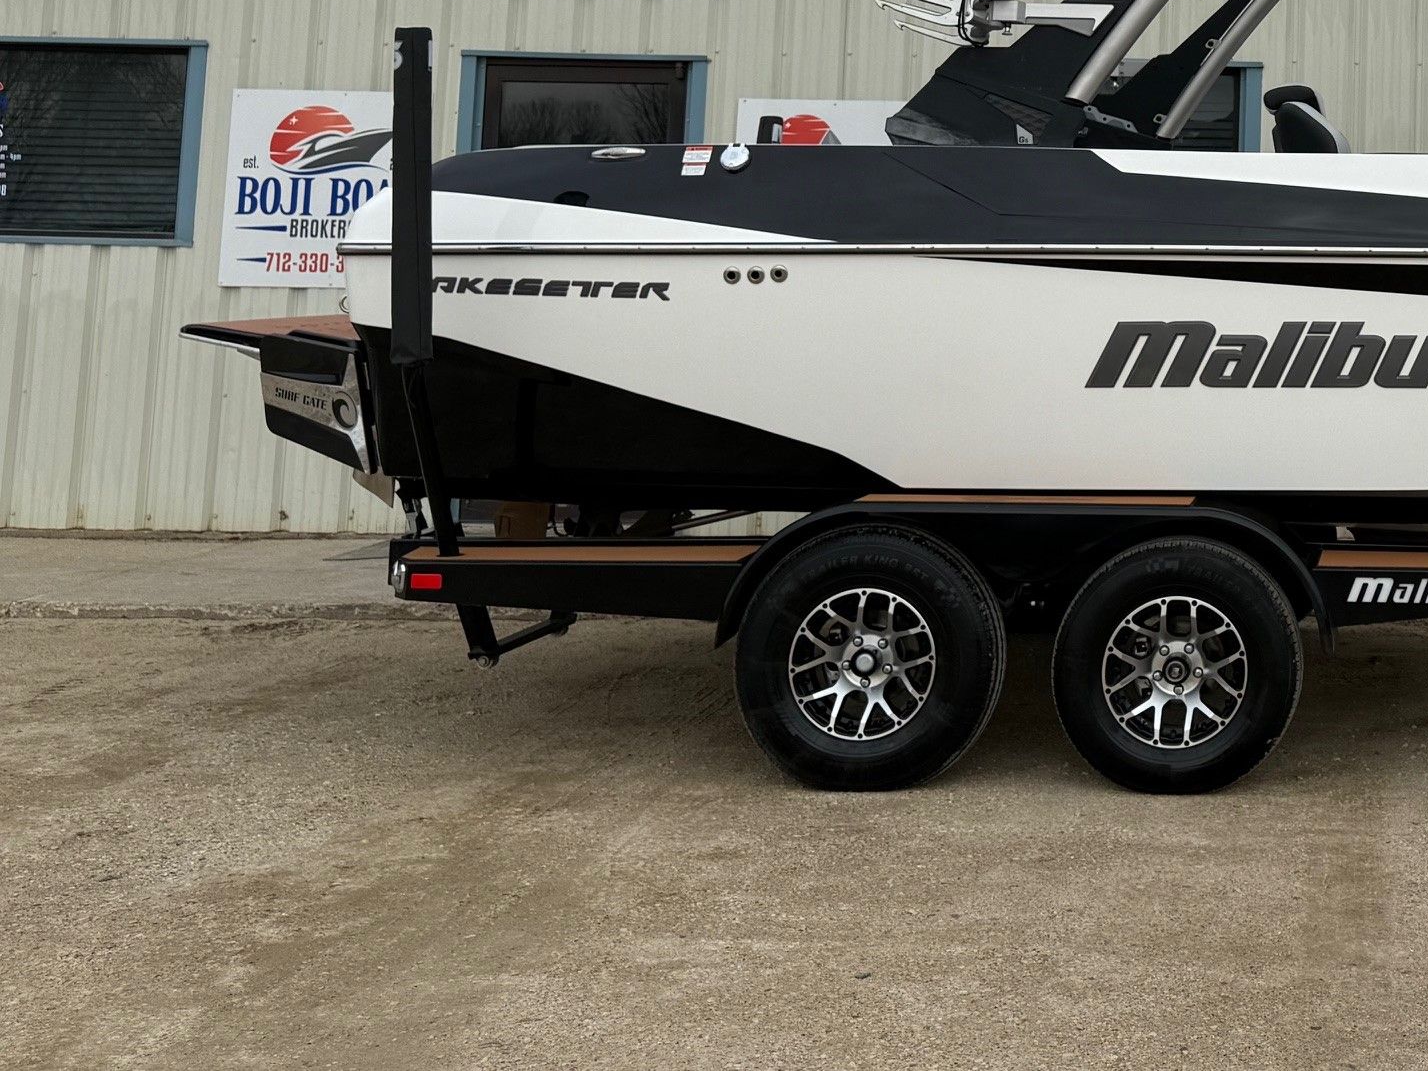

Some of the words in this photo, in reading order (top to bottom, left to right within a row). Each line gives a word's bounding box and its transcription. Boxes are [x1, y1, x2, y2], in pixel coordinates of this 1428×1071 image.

[242, 155, 259, 169] est.
[234, 175, 316, 216] BOJI
[327, 177, 389, 216] BO
[289, 219, 351, 239] BROKER
[265, 251, 344, 273] 712-330-3
[432, 276, 670, 301] AKESETTER
[275, 387, 300, 402] SURF
[303, 395, 328, 410] GATE
